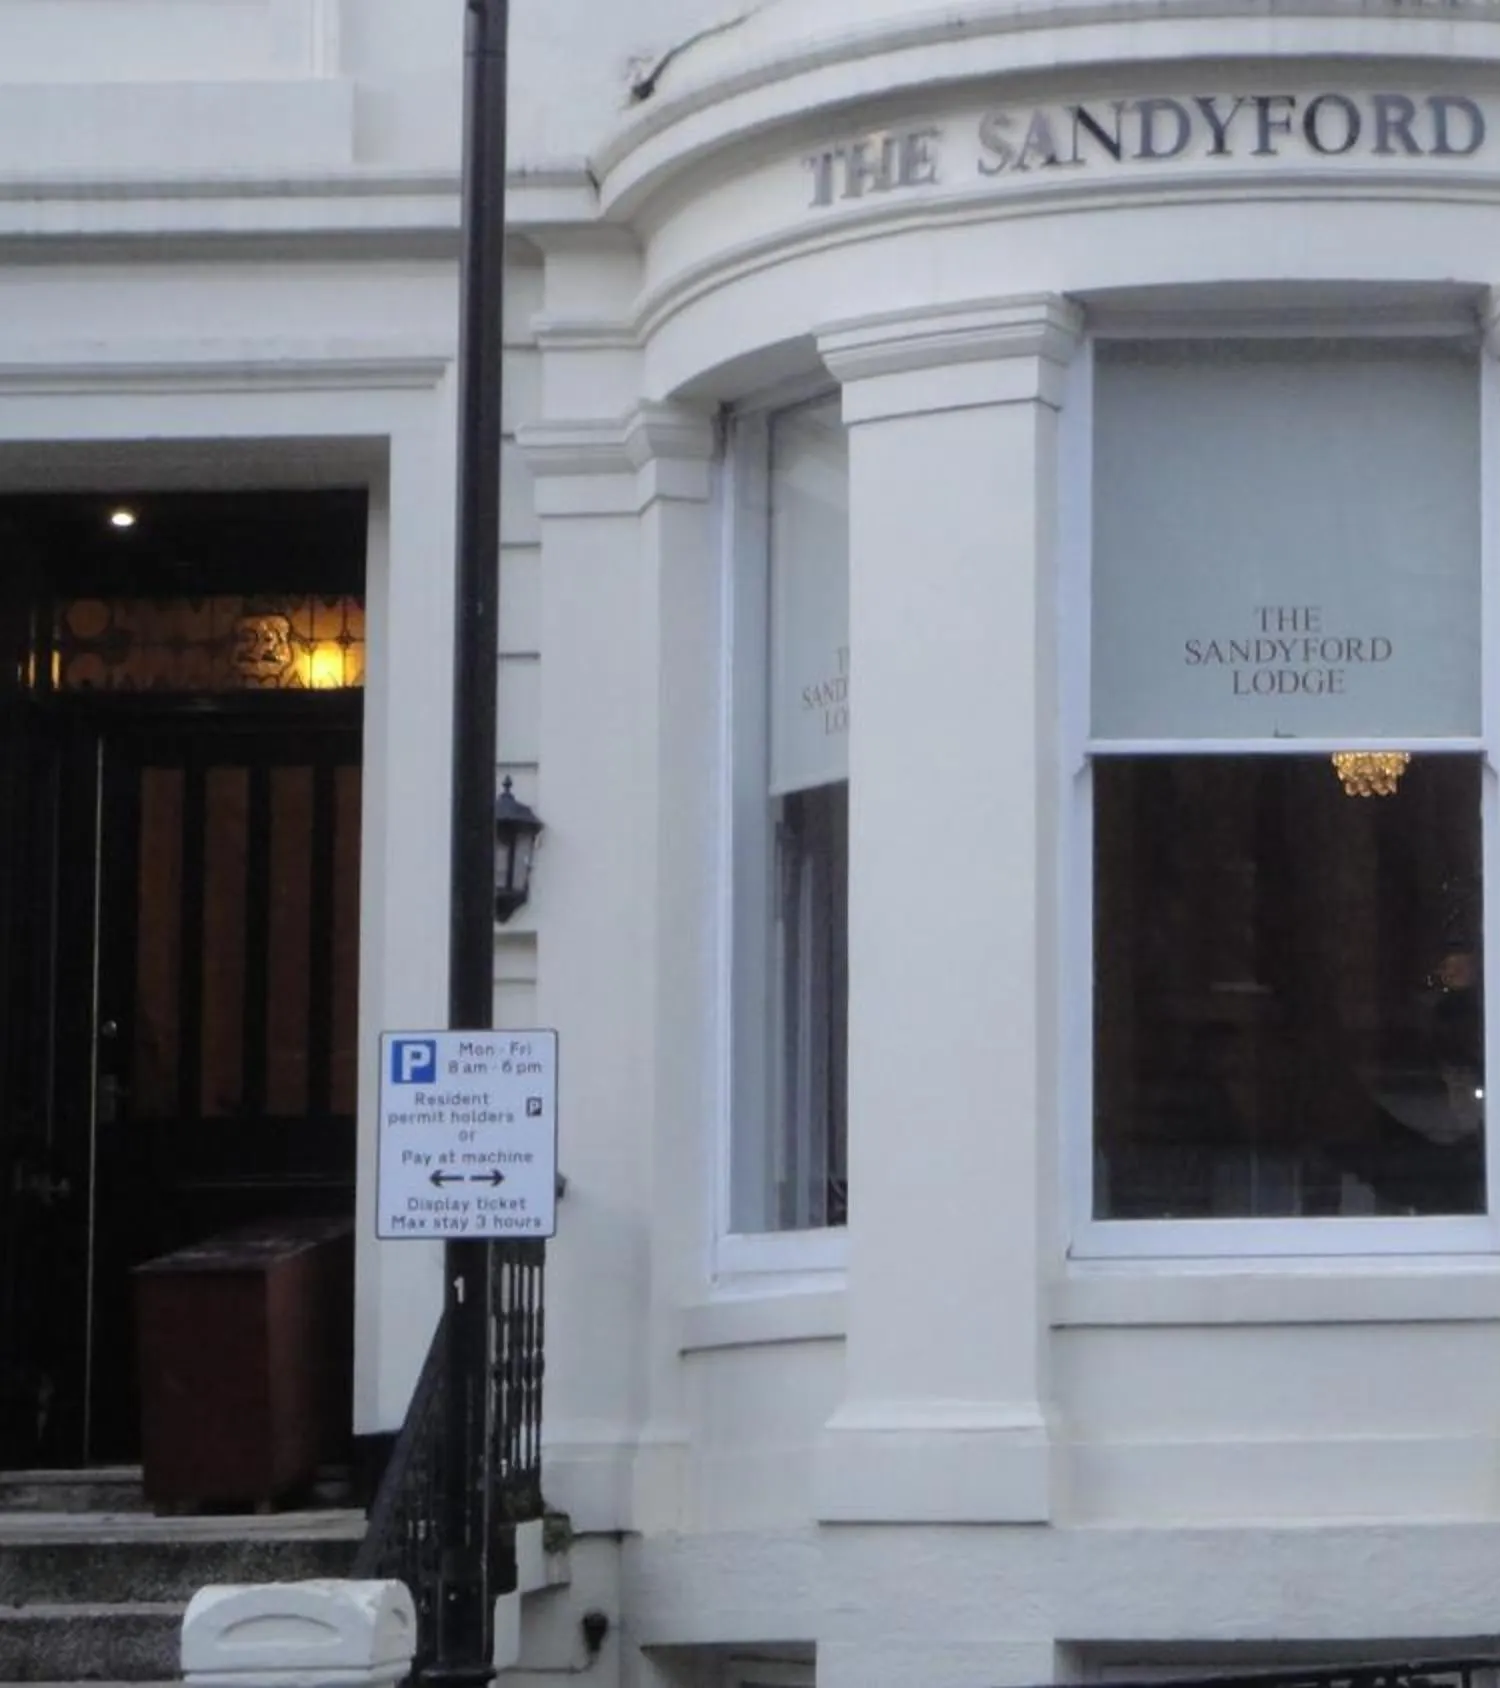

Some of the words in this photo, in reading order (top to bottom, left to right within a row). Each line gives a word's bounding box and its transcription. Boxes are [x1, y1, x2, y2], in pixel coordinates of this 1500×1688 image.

[804, 124, 942, 208] THE
[976, 92, 1486, 176] SANDYFORD
[1254, 606, 1322, 632] THE
[1184, 637, 1393, 666] SANDYFORD
[1232, 668, 1346, 695] LODGE
[459, 1042, 495, 1057] Mon
[509, 1042, 532, 1057] Fri
[401, 1043, 431, 1081] P
[414, 1091, 489, 1106] Resident
[387, 1112, 444, 1127] permit
[450, 1111, 515, 1124] holders
[458, 1129, 476, 1142] or
[401, 1151, 432, 1166] Pay
[438, 1151, 455, 1163] at
[461, 1150, 533, 1163] machine
[407, 1197, 470, 1213] Display
[477, 1197, 527, 1211] ticket
[391, 1215, 427, 1231] Max
[433, 1215, 470, 1232] stay
[493, 1215, 542, 1229] hours
